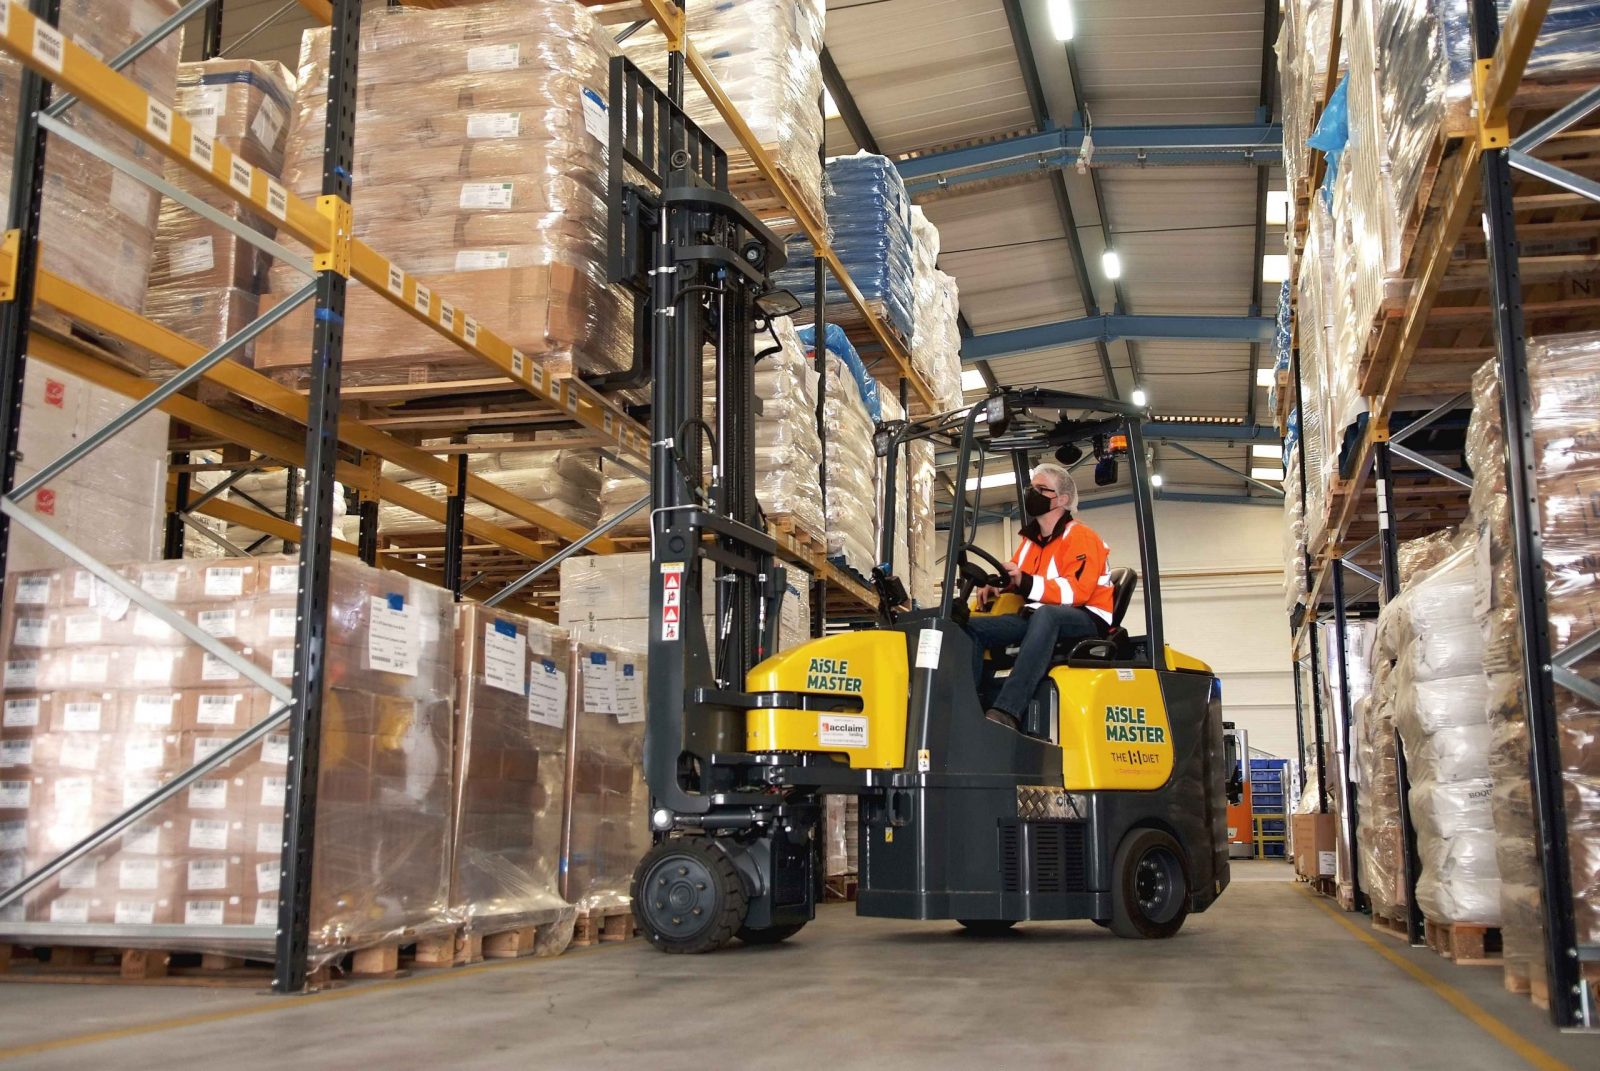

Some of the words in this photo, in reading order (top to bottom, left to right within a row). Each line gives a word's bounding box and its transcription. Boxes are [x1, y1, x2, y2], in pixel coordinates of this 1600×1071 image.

[807, 674, 862, 692] MASTER
[829, 723, 864, 733] acclaim
[1105, 724, 1164, 743] MASTER
[1111, 752, 1127, 763] THE
[1142, 753, 1159, 764] DIET
